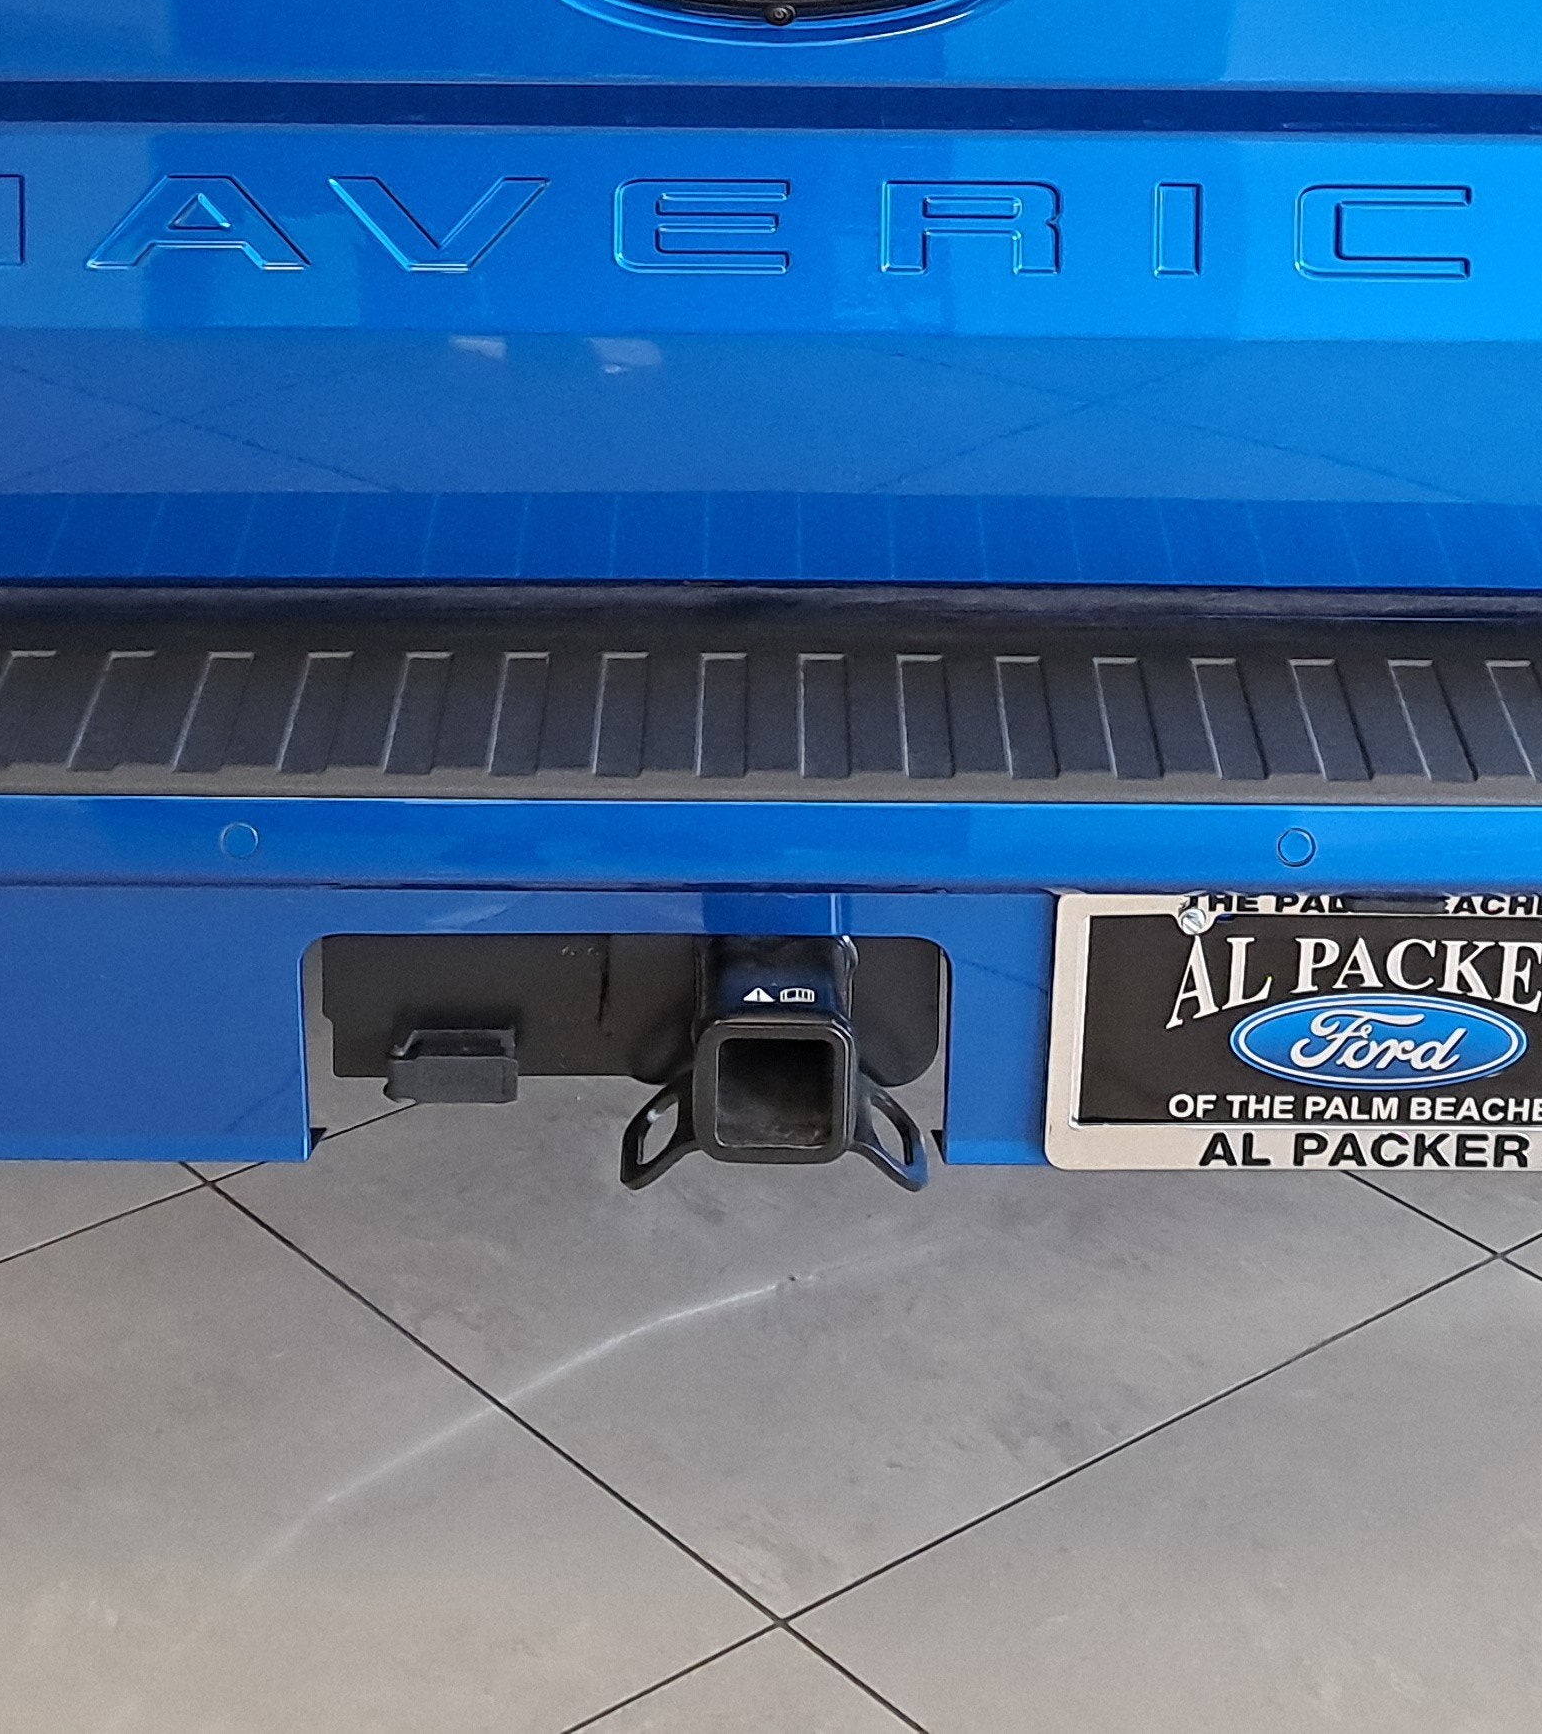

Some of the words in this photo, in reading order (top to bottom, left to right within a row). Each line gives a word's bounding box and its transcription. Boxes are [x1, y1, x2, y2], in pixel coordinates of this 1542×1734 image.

[1164, 934, 1273, 1030] AL
[1289, 1009, 1468, 1072] Ford
[1167, 1094, 1216, 1120] OF
[1226, 1094, 1297, 1121] THE
[1303, 1095, 1398, 1122] PALM
[1199, 1133, 1271, 1166] AL
[1292, 1133, 1530, 1168] PACKER
